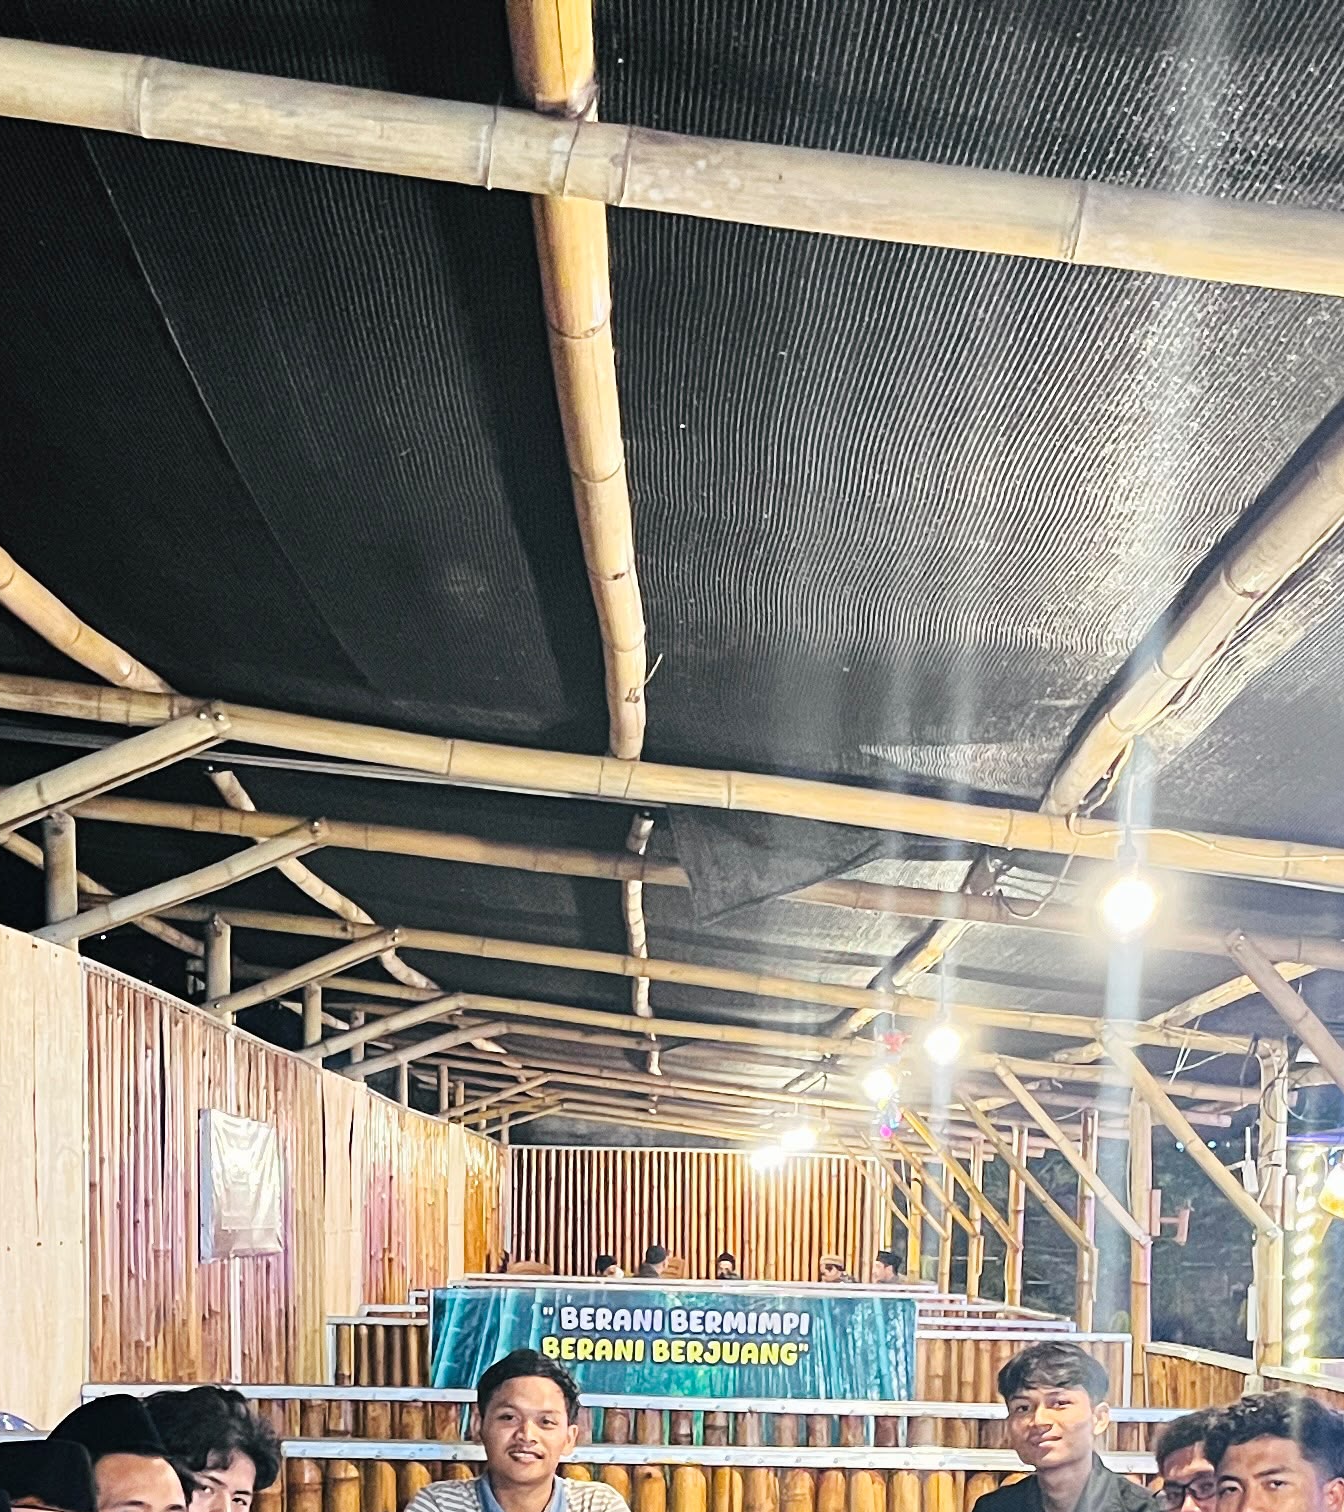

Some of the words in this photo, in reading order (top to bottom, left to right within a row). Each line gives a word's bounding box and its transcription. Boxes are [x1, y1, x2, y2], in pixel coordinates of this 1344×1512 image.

[670, 1308, 810, 1336] BERMIMPI
[542, 1336, 645, 1362] BERANI
[652, 1339, 809, 1366] BERJUANG"
